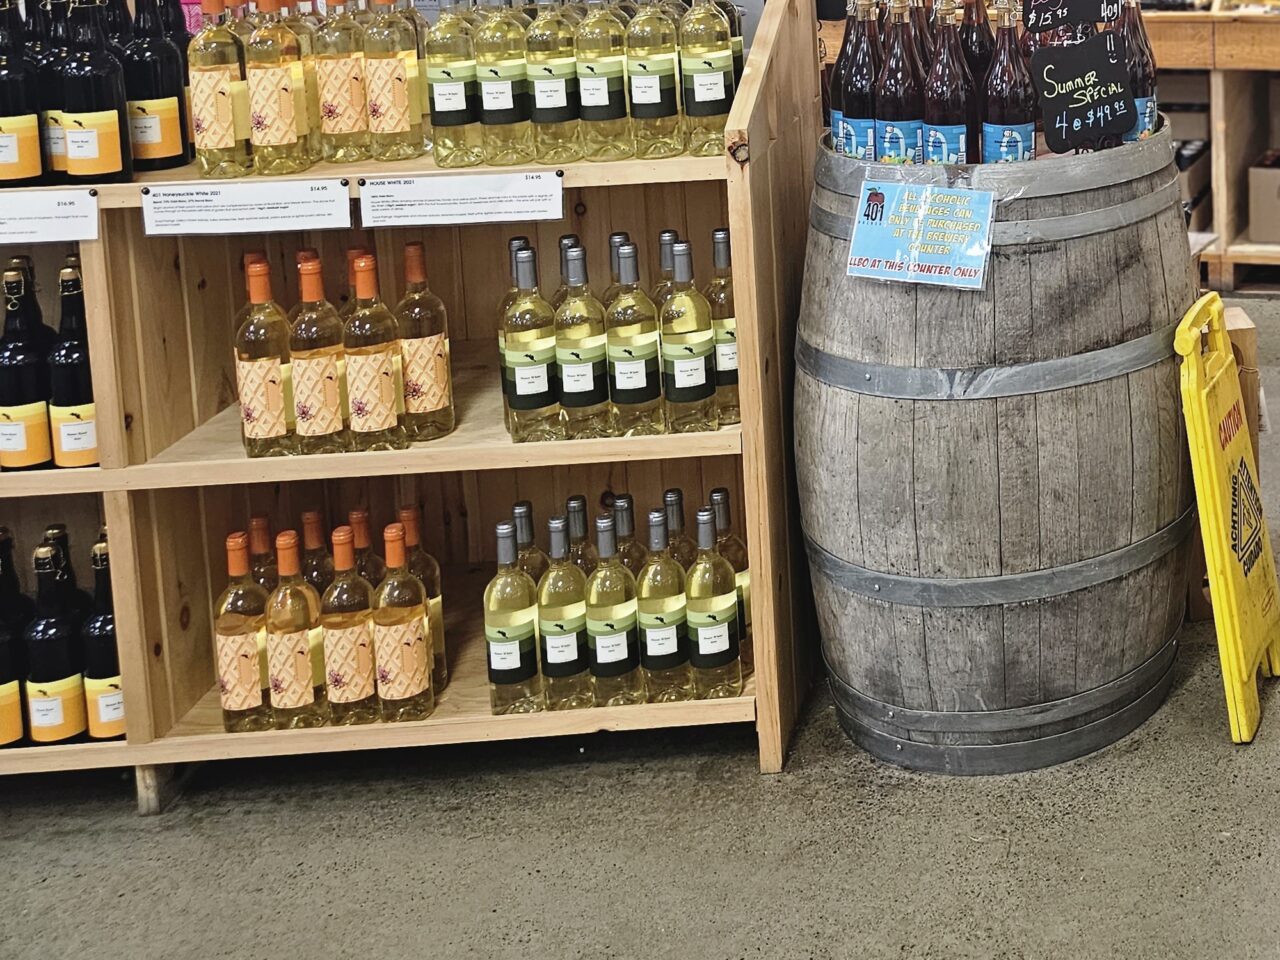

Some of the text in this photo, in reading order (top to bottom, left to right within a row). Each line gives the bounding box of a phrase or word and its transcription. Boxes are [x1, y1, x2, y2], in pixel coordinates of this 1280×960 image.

[1055, 110, 1069, 140] 4
[864, 202, 885, 222] 401
[903, 191, 917, 201] ALL
[953, 207, 973, 219] CAN
[888, 214, 910, 226] ONLY
[927, 218, 981, 232] PURCHASED
[893, 228, 904, 238] AT
[926, 230, 972, 244] BREWERY
[908, 242, 952, 255] COUNTER
[870, 258, 883, 269] AT
[884, 259, 905, 272] THIS
[906, 261, 952, 276] COUNTER
[953, 266, 981, 278] ONLY
[1218, 399, 1244, 452] CAUTION
[1230, 474, 1239, 554] ACHTUNG
